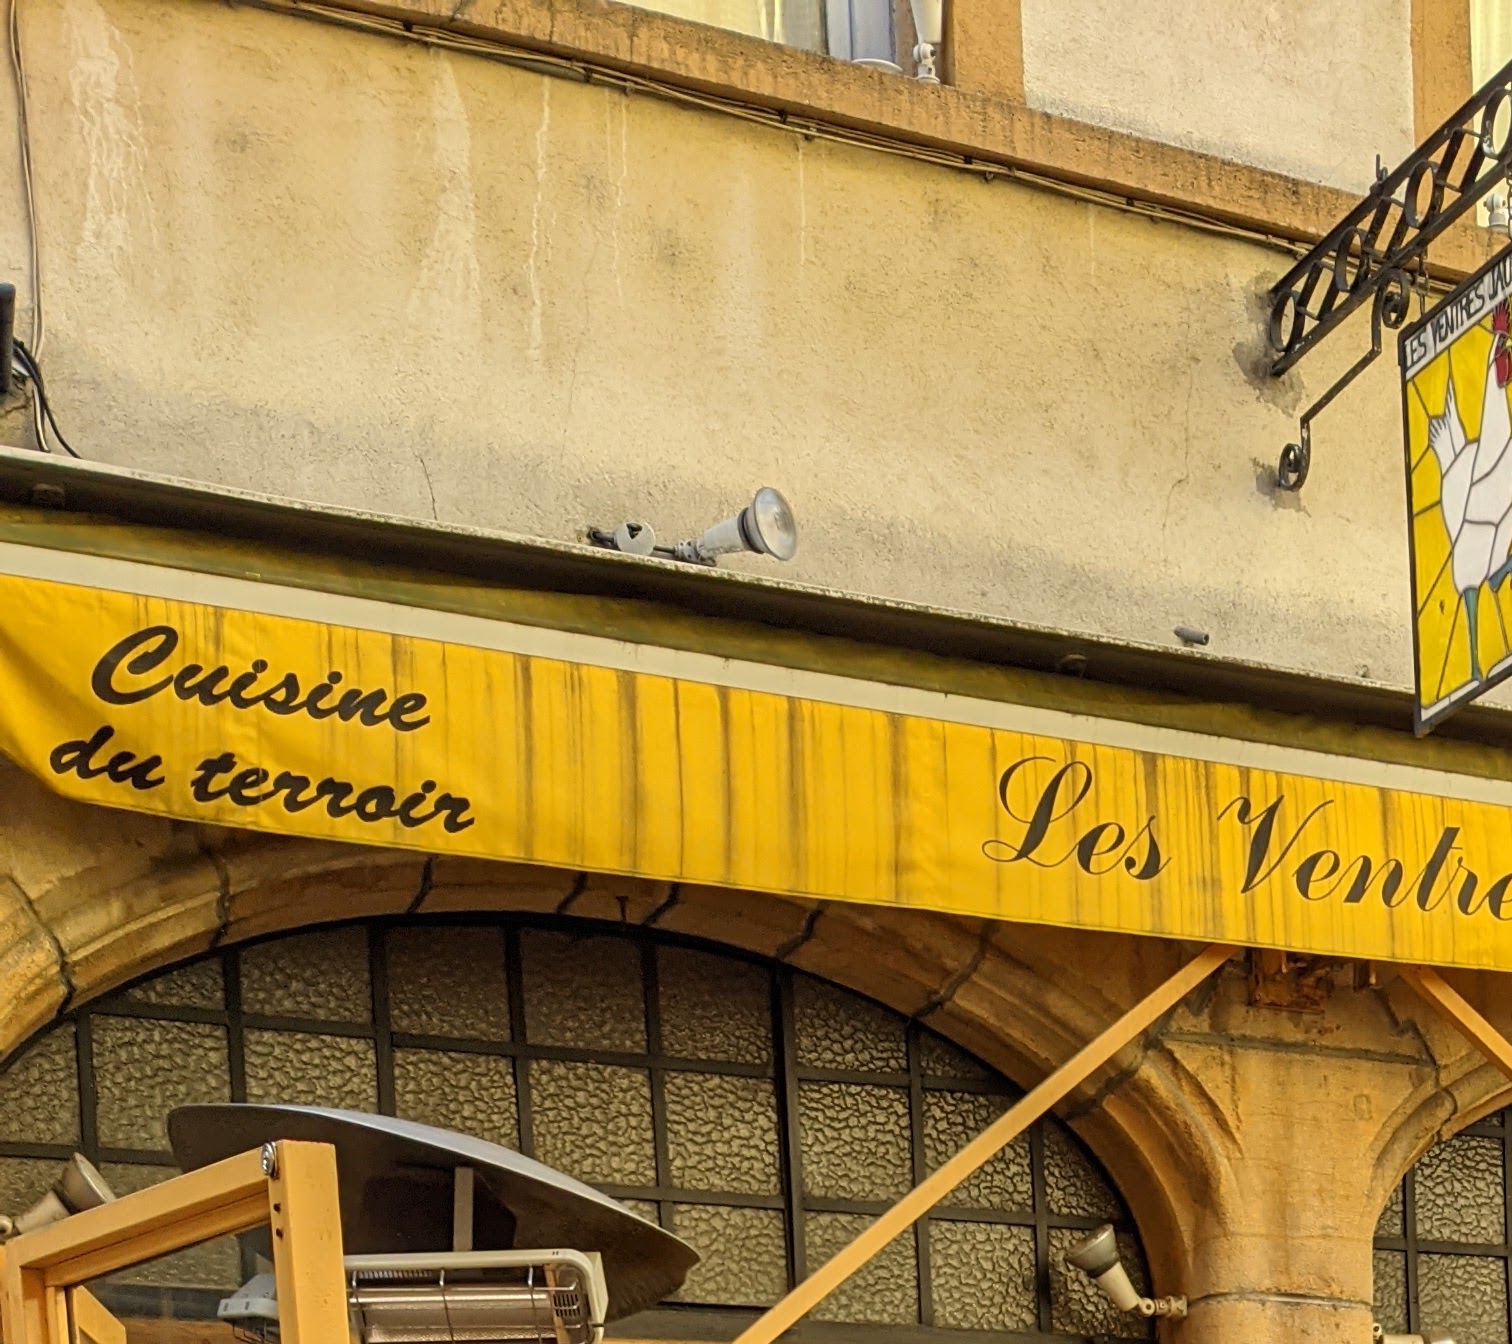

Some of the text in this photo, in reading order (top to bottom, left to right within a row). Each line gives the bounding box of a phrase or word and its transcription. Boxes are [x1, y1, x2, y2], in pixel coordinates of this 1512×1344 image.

[1430, 278, 1485, 348] VENTRES
[92, 625, 431, 732] Cuisine
[50, 726, 475, 834] du terroir
[982, 756, 1171, 882] Les
